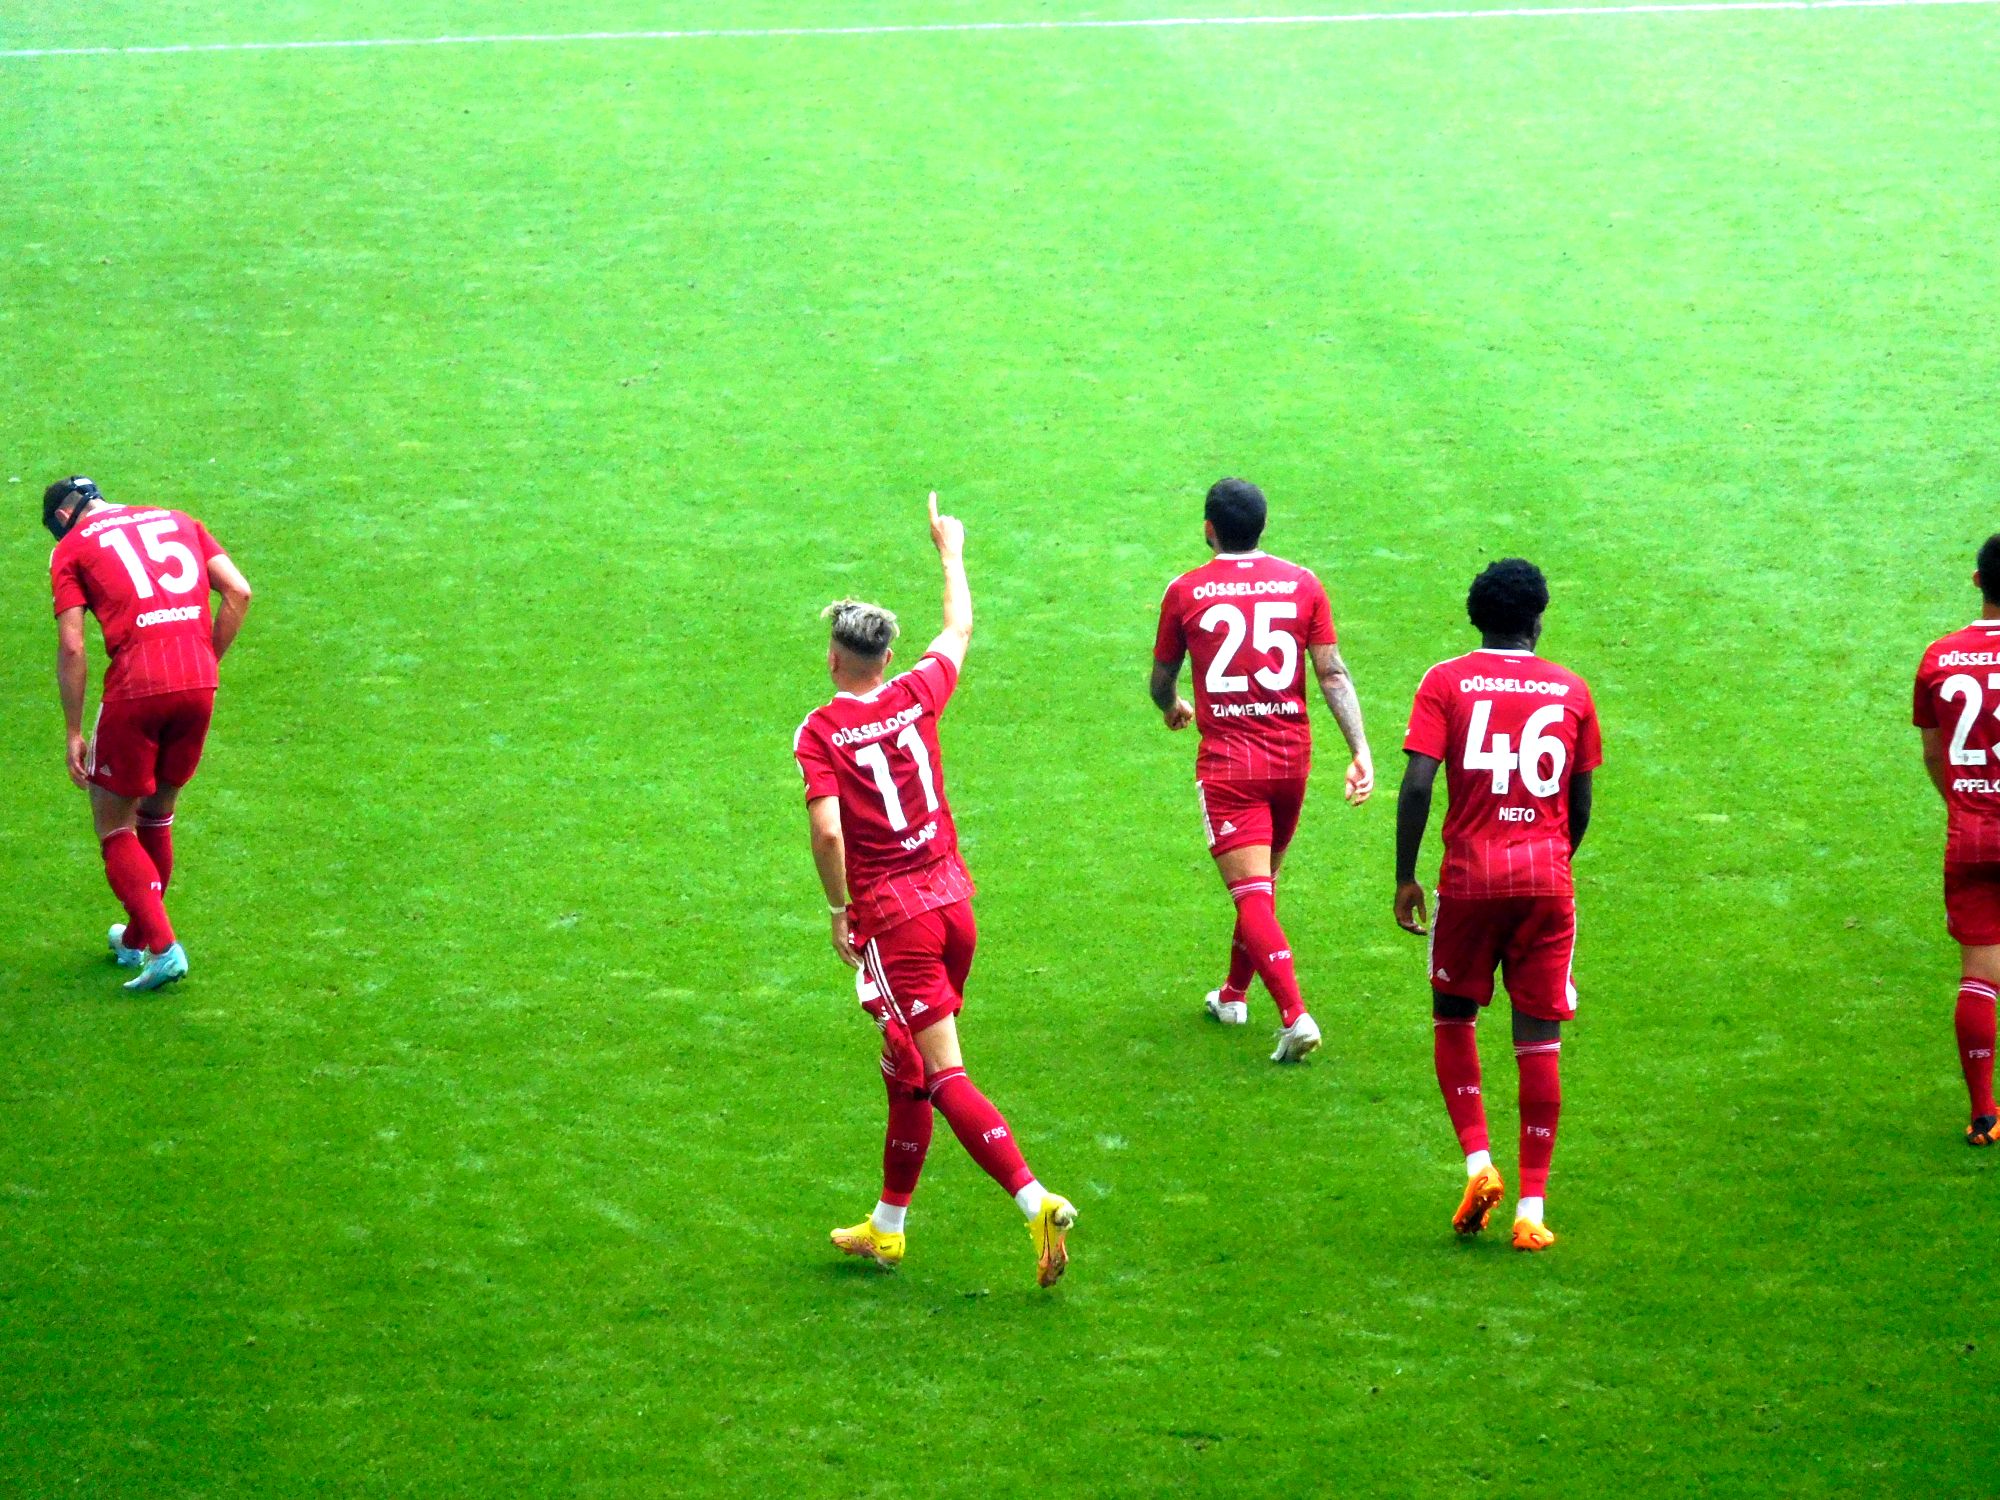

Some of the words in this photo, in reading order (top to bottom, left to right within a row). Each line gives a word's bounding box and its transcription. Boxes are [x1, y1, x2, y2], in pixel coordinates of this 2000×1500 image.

[99, 519, 199, 599] 15
[1193, 581, 1298, 600] DÜSSELDORF
[1199, 602, 1298, 692] 25
[1938, 650, 2000, 667] DÜSSEL
[1460, 675, 1570, 696] DÜSSELDORF
[831, 703, 923, 747] DÜSSELDORF
[1463, 700, 1567, 798] 46
[855, 723, 939, 832] 11
[1498, 807, 1535, 822] NETO
